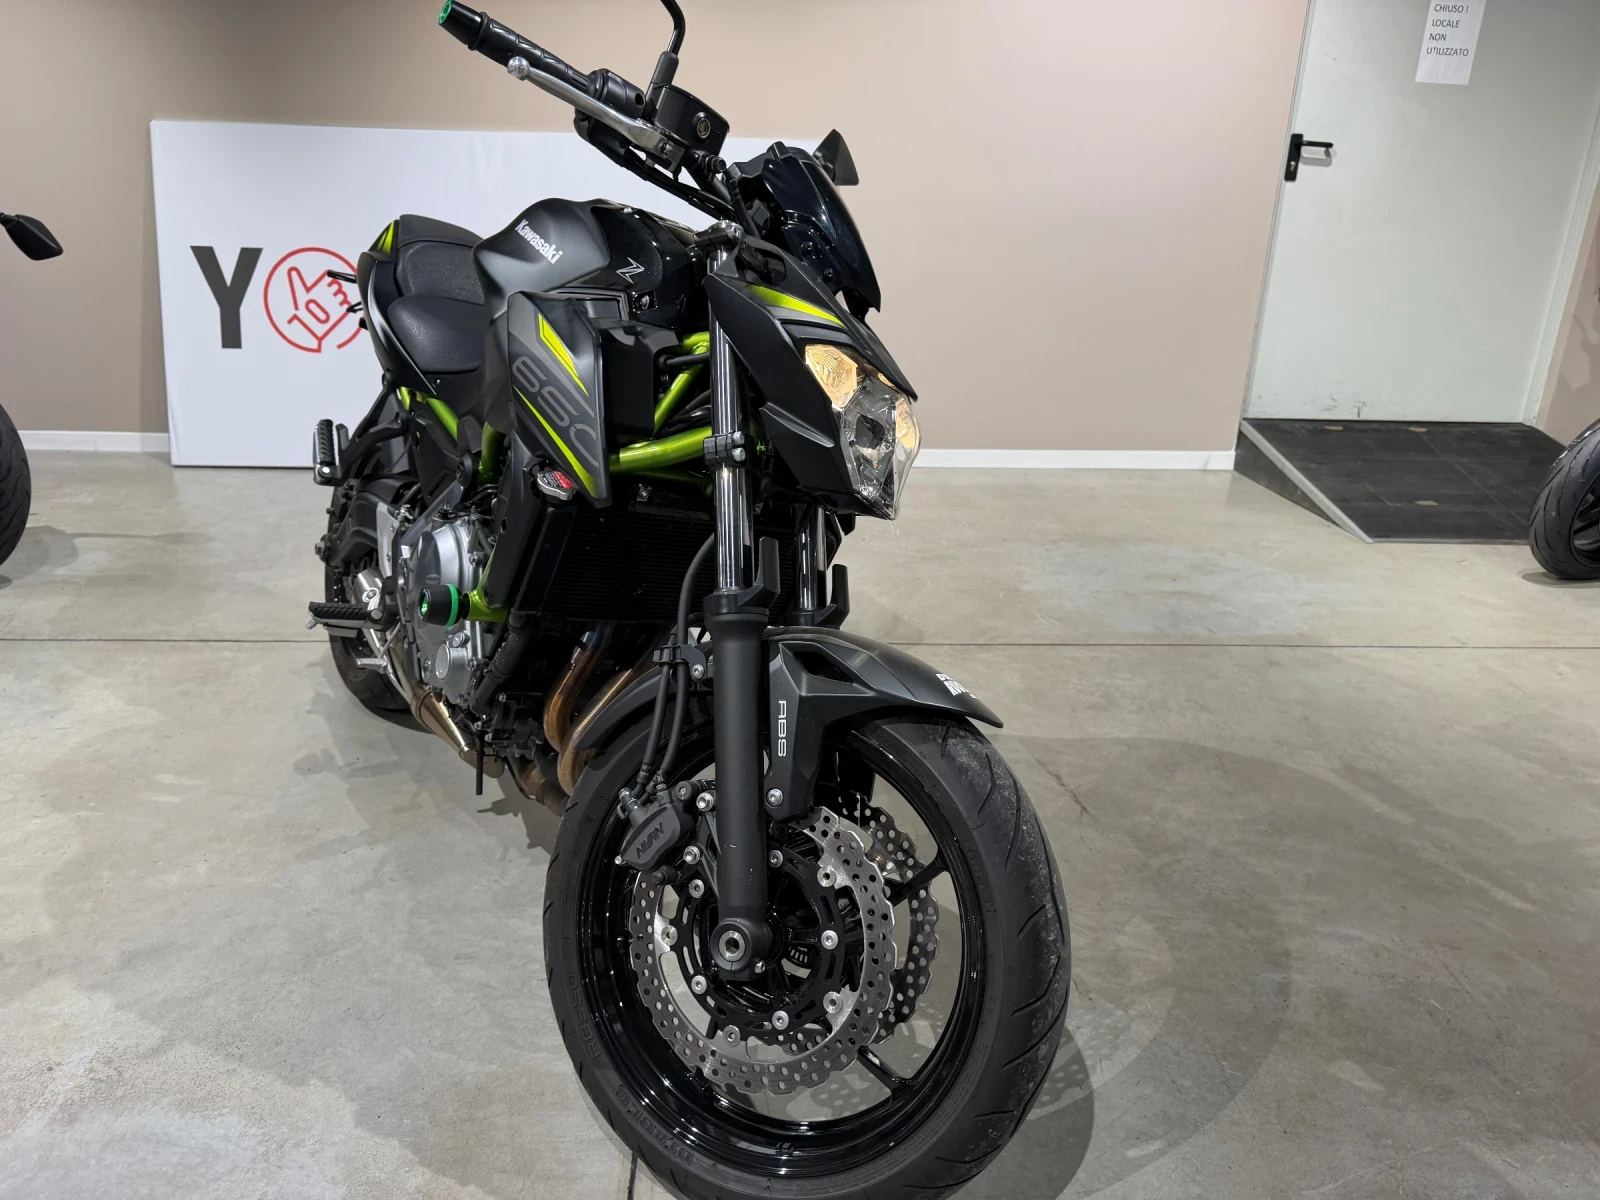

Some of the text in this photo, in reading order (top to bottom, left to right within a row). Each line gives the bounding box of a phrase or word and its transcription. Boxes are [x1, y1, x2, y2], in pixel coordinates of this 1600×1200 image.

[1434, 4, 1464, 13] CHIUSO
[1429, 33, 1447, 41] NON
[1432, 19, 1460, 28] LOCALE
[1426, 47, 1469, 56] UTILIZZATO
[514, 218, 564, 265] Kawasaki
[778, 700, 787, 757] ABS
[567, 973, 602, 1059] ROSSO
[615, 1083, 694, 1166] DIABLO
